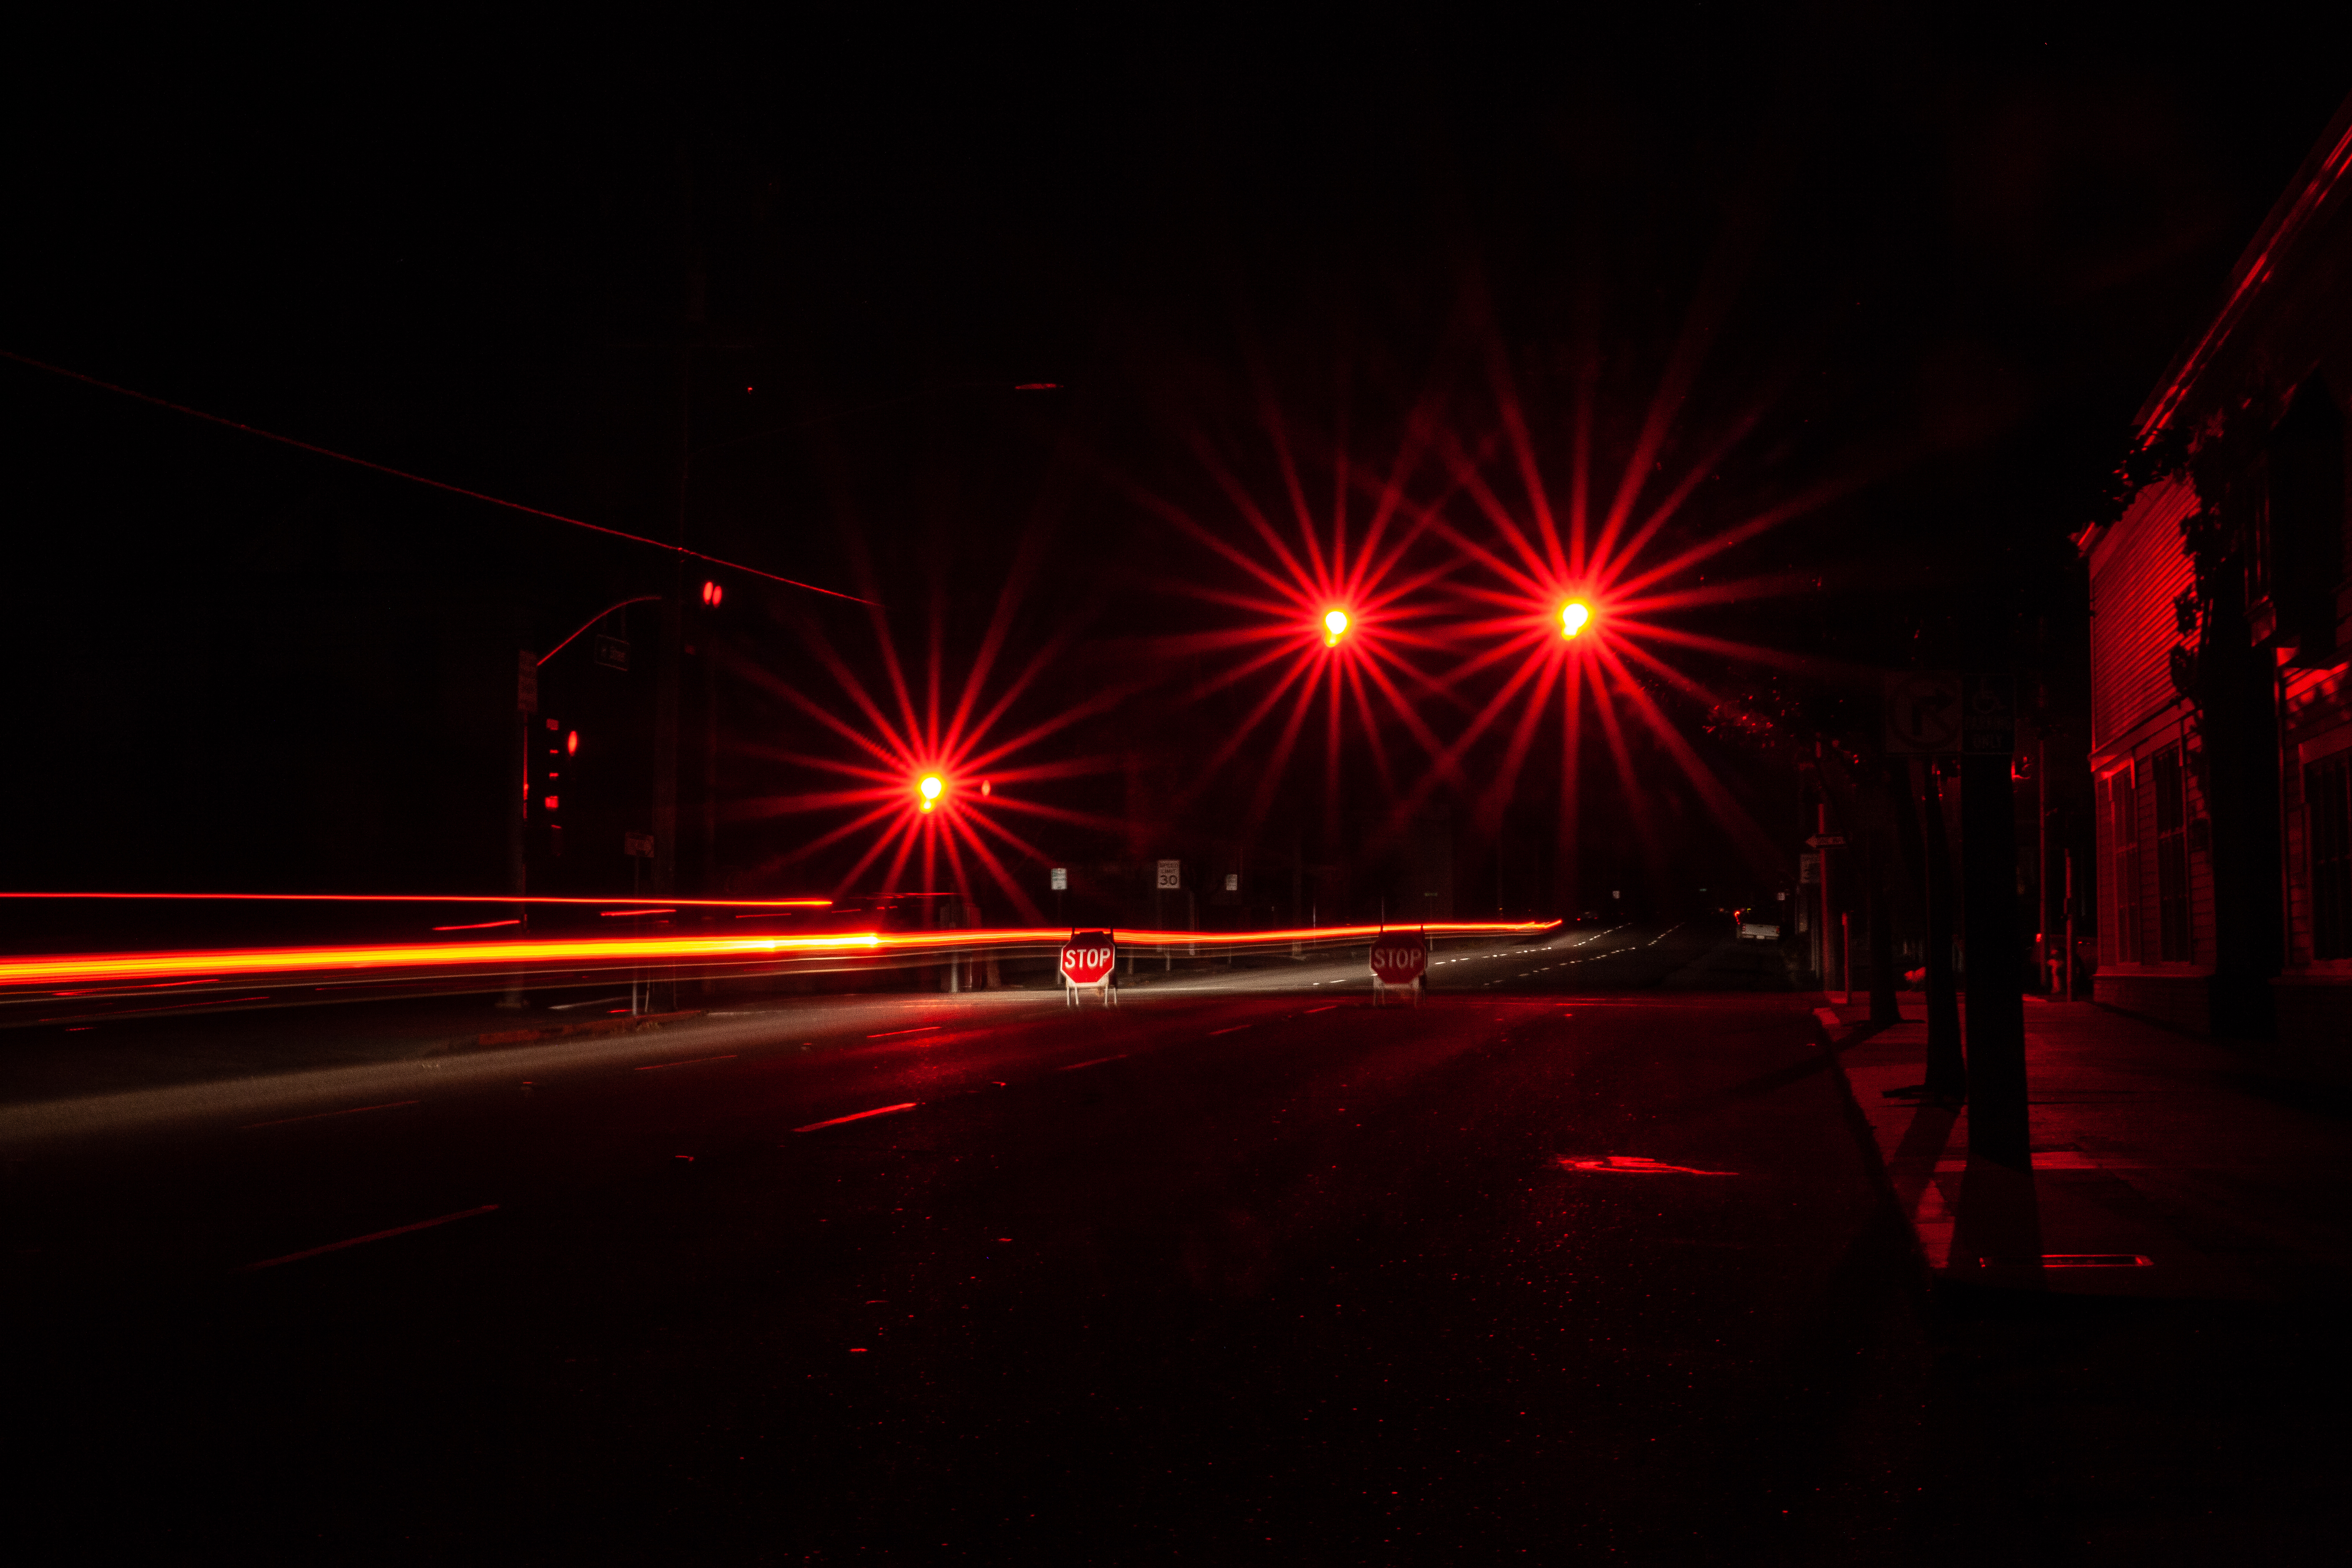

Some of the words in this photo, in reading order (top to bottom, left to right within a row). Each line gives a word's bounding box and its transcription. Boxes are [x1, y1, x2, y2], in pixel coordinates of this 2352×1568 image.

[1973, 734, 2003, 749] ONLY
[1160, 875, 1178, 885] 30
[1065, 948, 1111, 968] STOP
[1374, 948, 1422, 968] STOP
